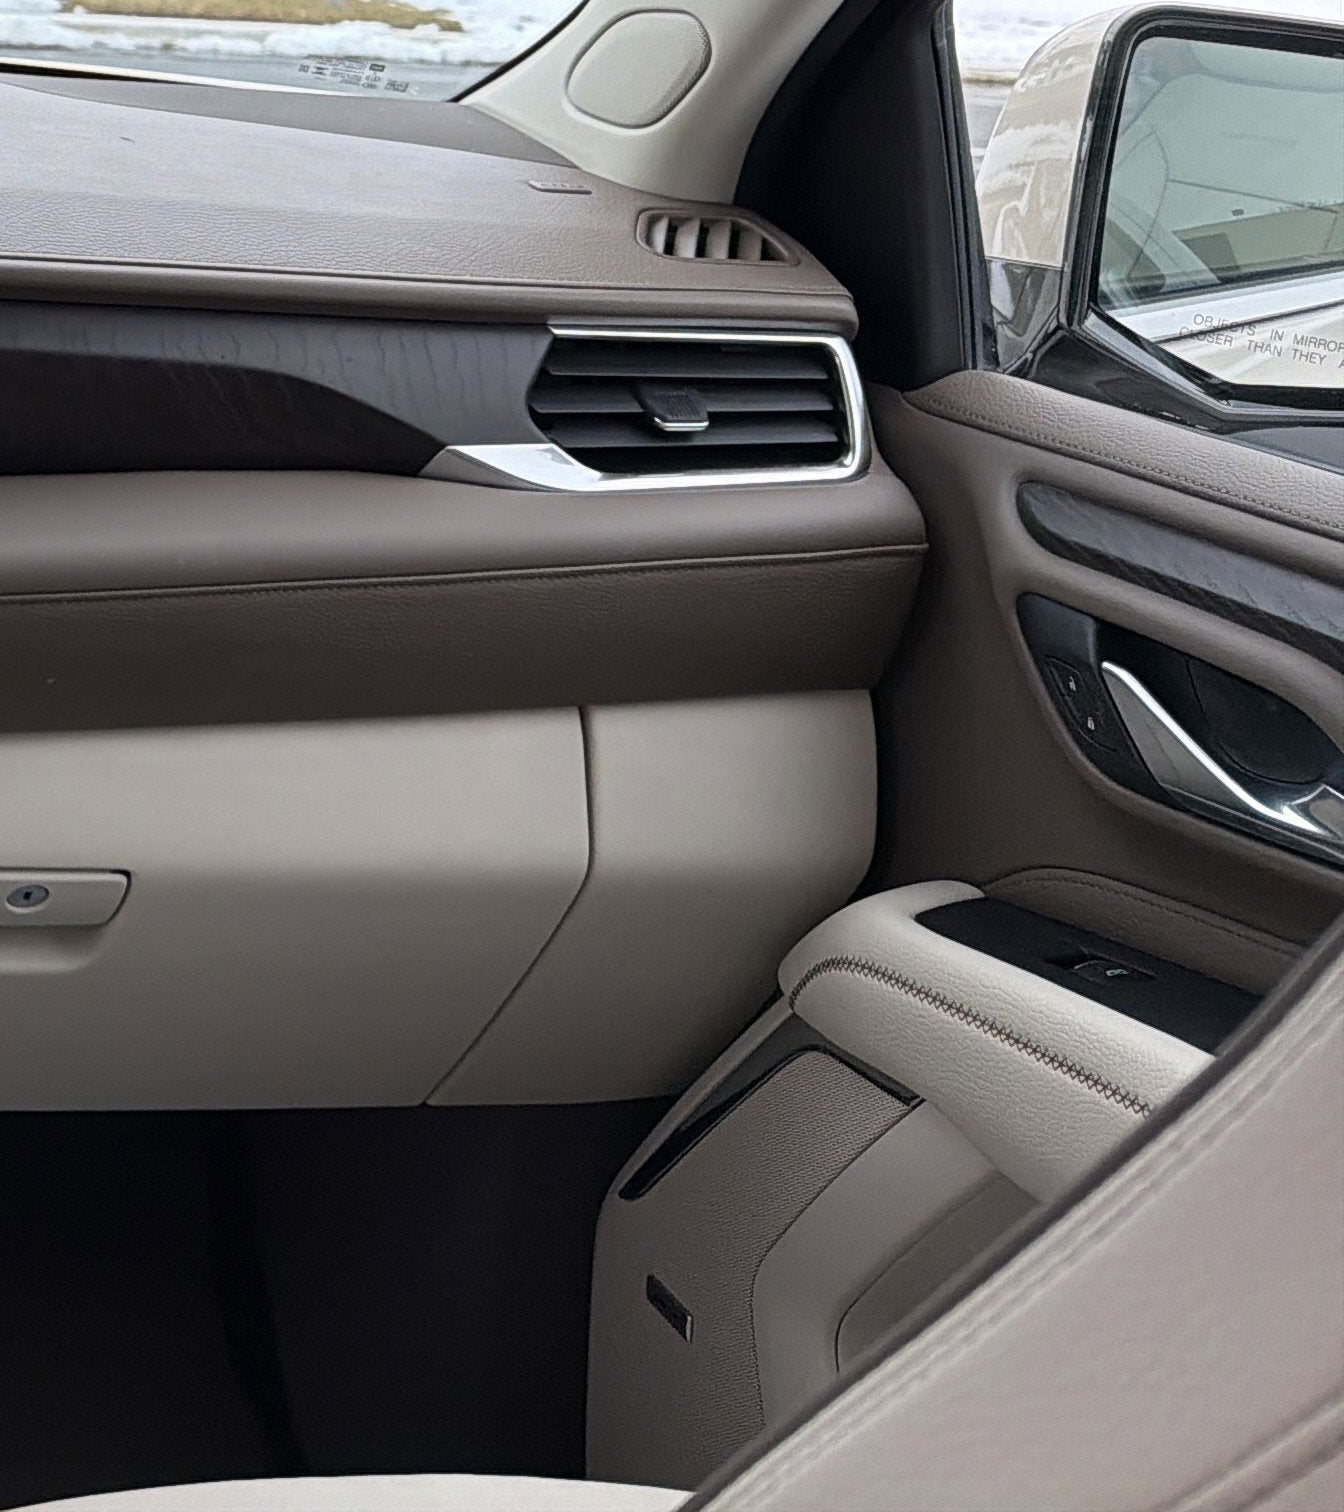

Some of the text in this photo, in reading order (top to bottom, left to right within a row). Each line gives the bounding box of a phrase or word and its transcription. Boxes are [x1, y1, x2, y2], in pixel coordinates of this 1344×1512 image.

[1193, 314, 1257, 337] OBJECTS
[1270, 328, 1284, 342] IN
[1247, 339, 1282, 358] THAN
[1292, 348, 1327, 365] THEY
